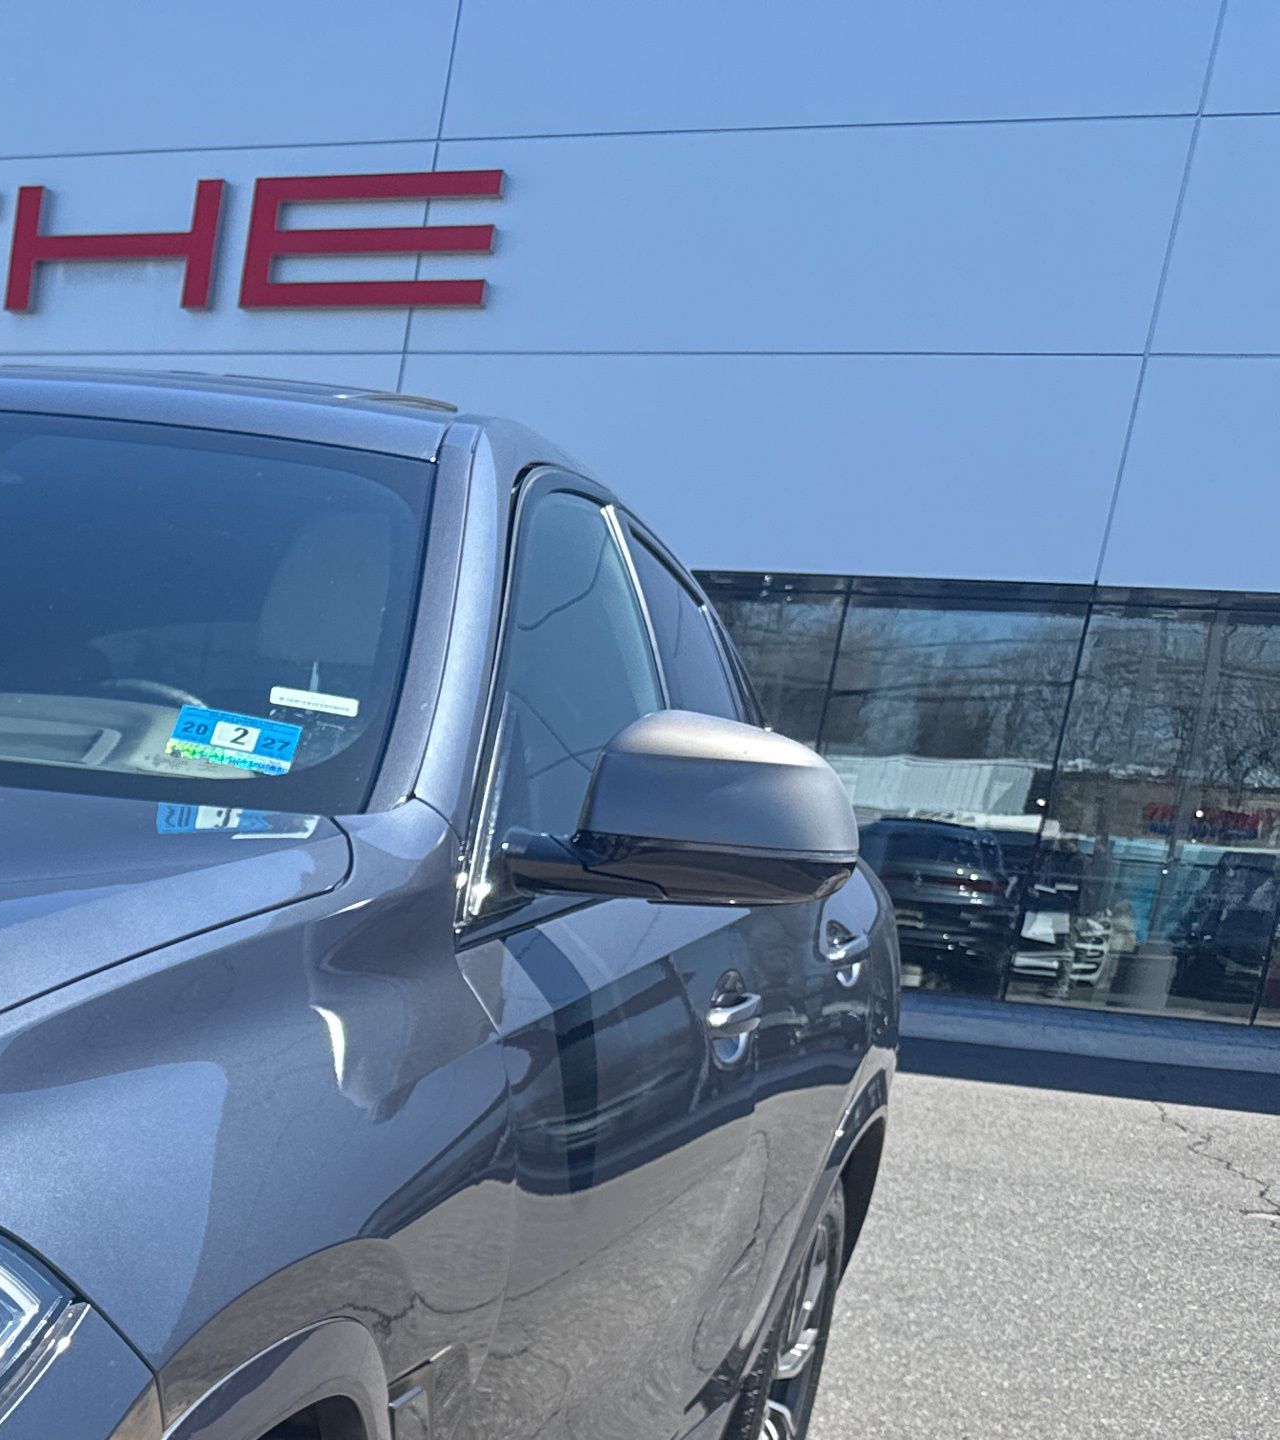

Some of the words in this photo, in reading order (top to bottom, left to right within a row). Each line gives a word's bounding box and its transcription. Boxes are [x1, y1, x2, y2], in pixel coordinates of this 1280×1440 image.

[181, 720, 208, 736] 20
[230, 726, 249, 746] 2
[261, 736, 291, 751] 27
